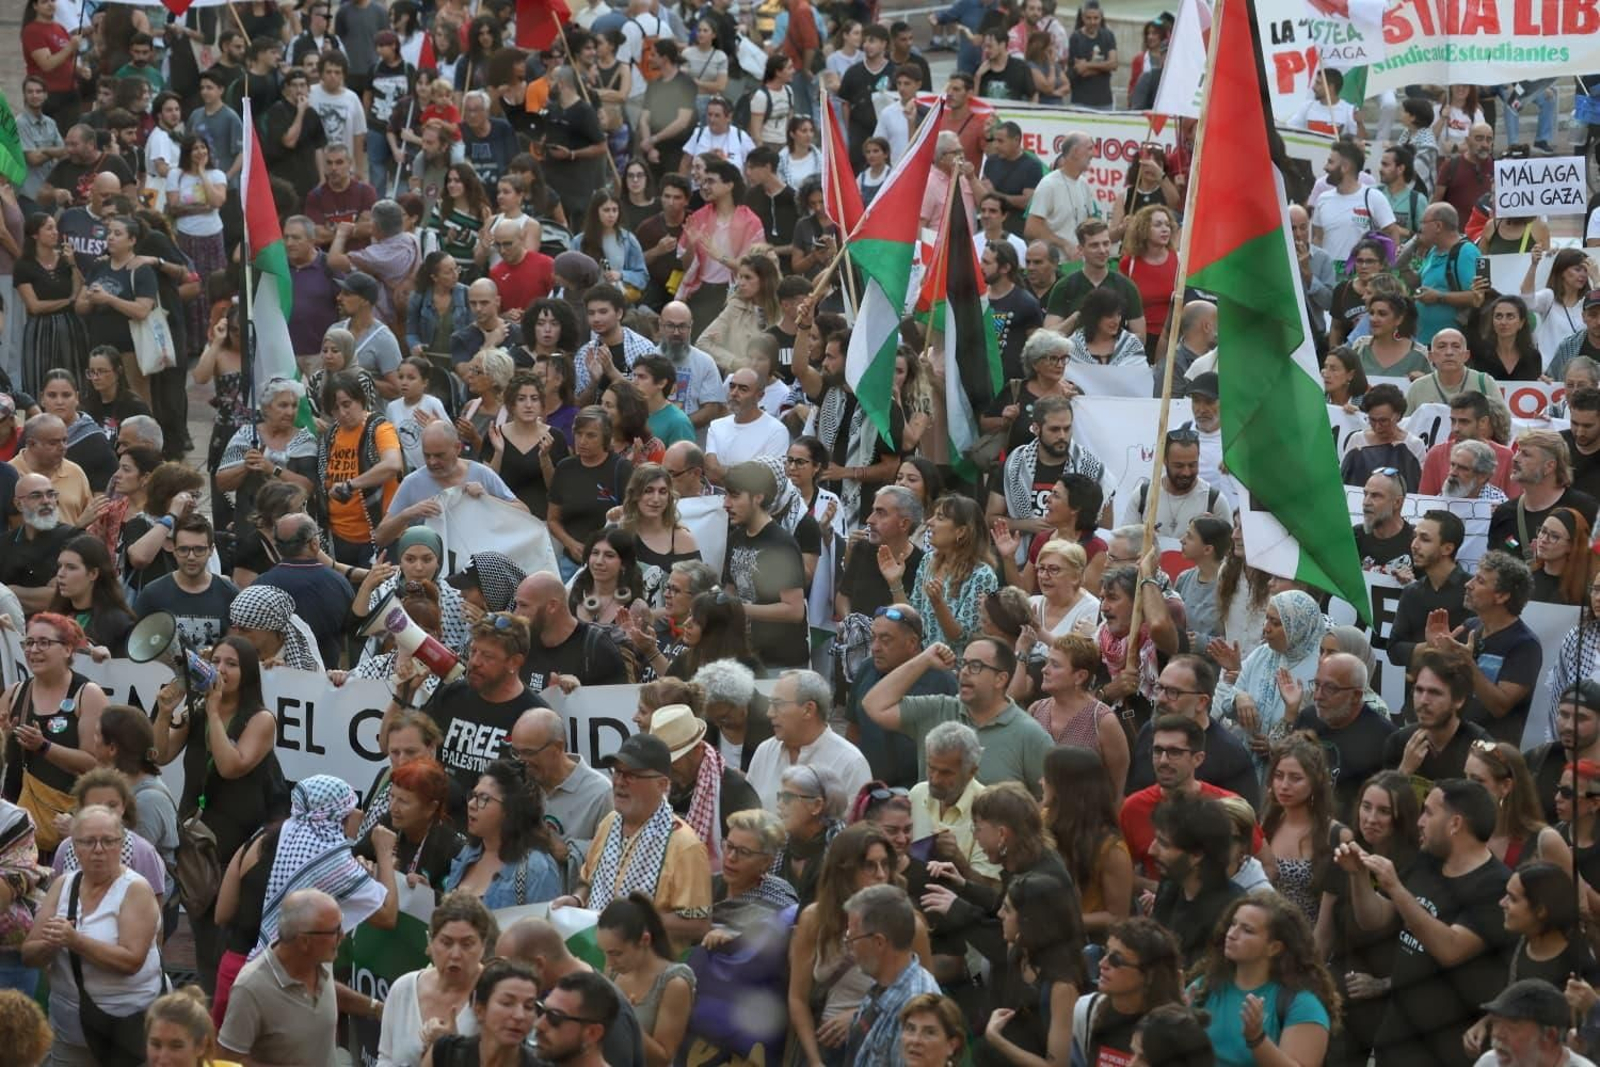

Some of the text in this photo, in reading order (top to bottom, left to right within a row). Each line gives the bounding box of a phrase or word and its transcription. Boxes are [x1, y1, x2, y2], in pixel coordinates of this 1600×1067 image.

[1270, 19, 1295, 45] LA
[1313, 20, 1364, 45] STEA
[1321, 46, 1367, 60] LAGA
[1443, 42, 1570, 63] Estudiantes
[1500, 161, 1581, 187] MÁLAGA
[1499, 187, 1584, 209] CON GAZA
[275, 696, 326, 755] EL
[443, 717, 508, 760] FREE
